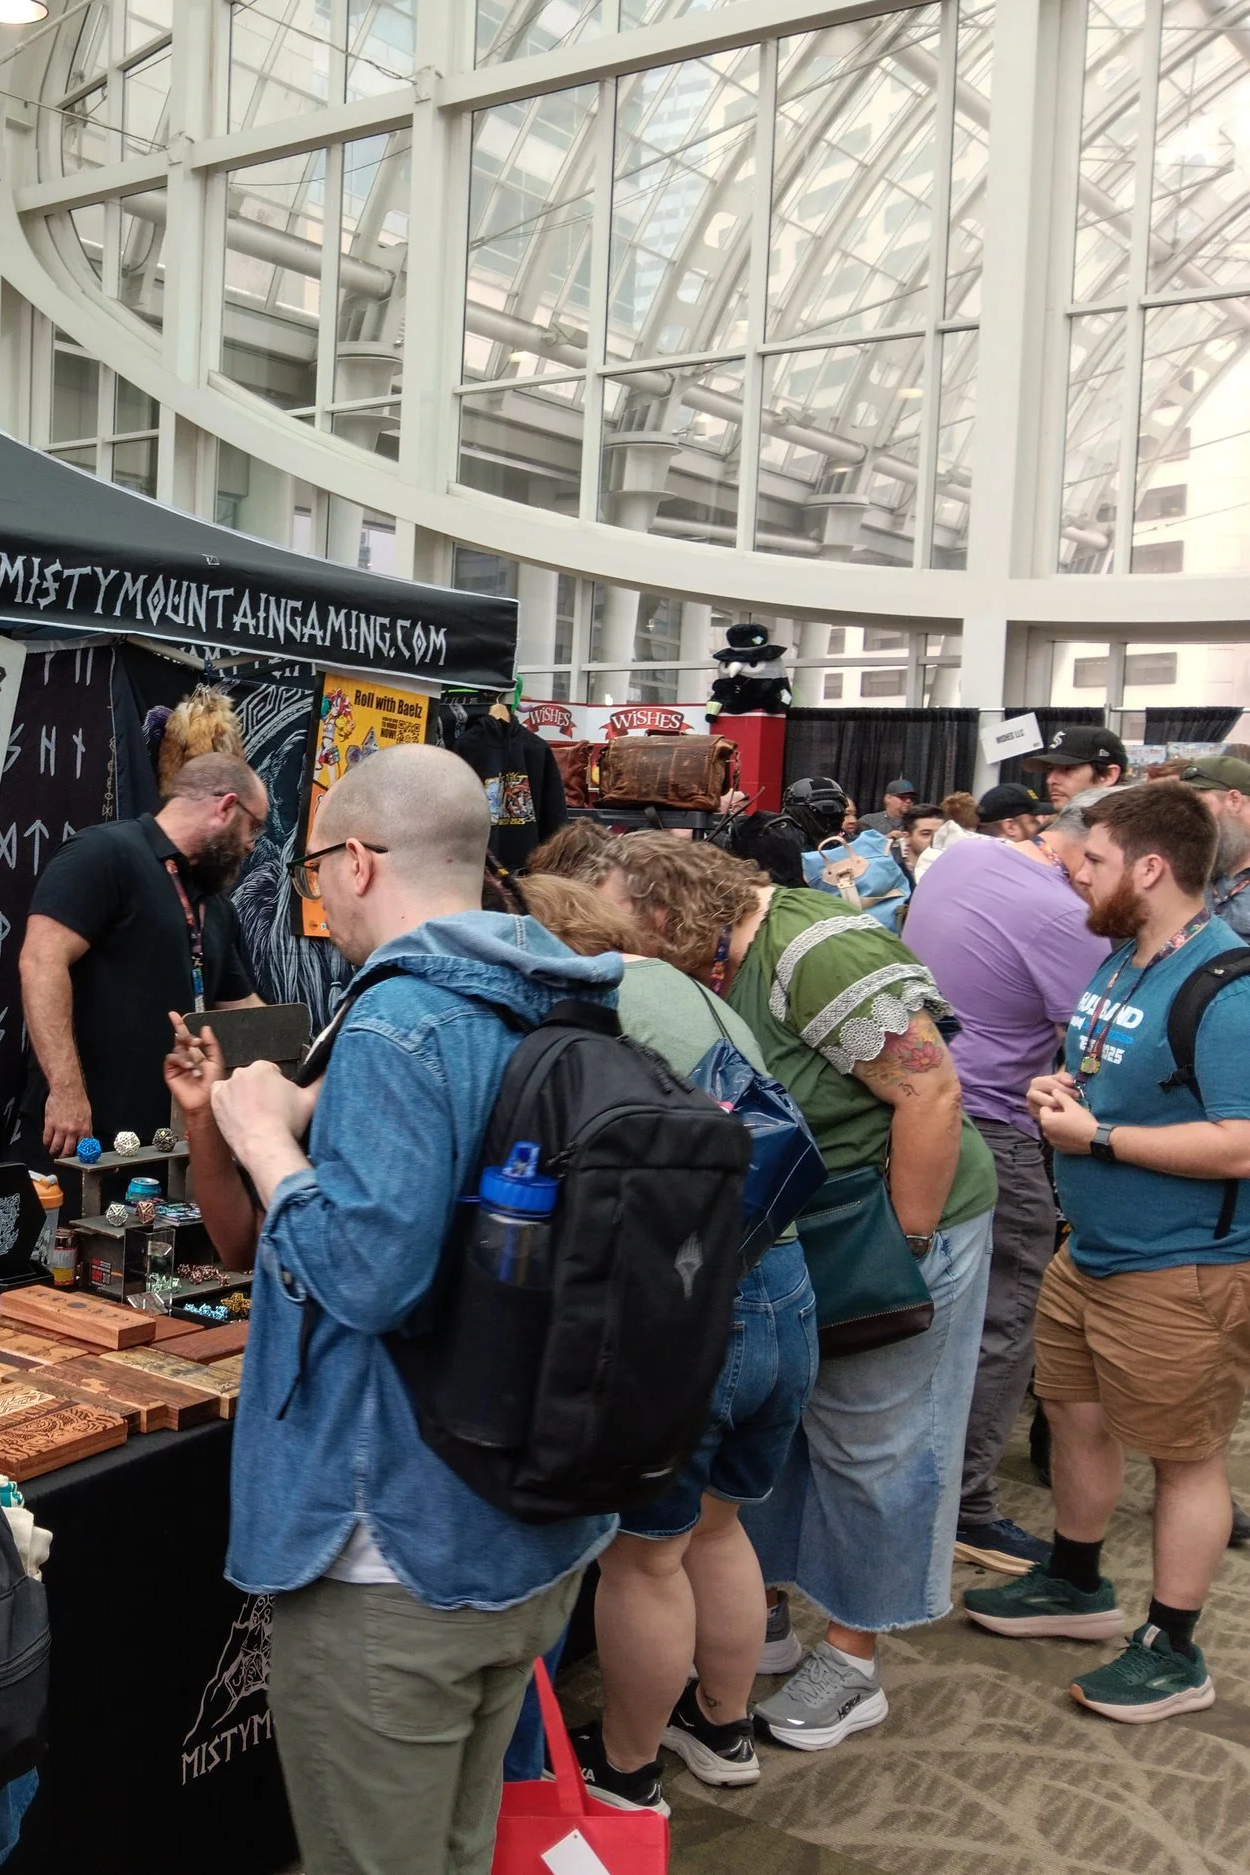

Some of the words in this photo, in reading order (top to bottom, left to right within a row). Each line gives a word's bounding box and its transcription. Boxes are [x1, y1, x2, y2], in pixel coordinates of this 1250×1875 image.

[354, 689, 375, 708] Roll
[375, 695, 397, 713] with
[397, 699, 423, 719] Baelz
[838, 1694, 860, 1721] HOKA
[182, 1709, 272, 1786] MISTYM
